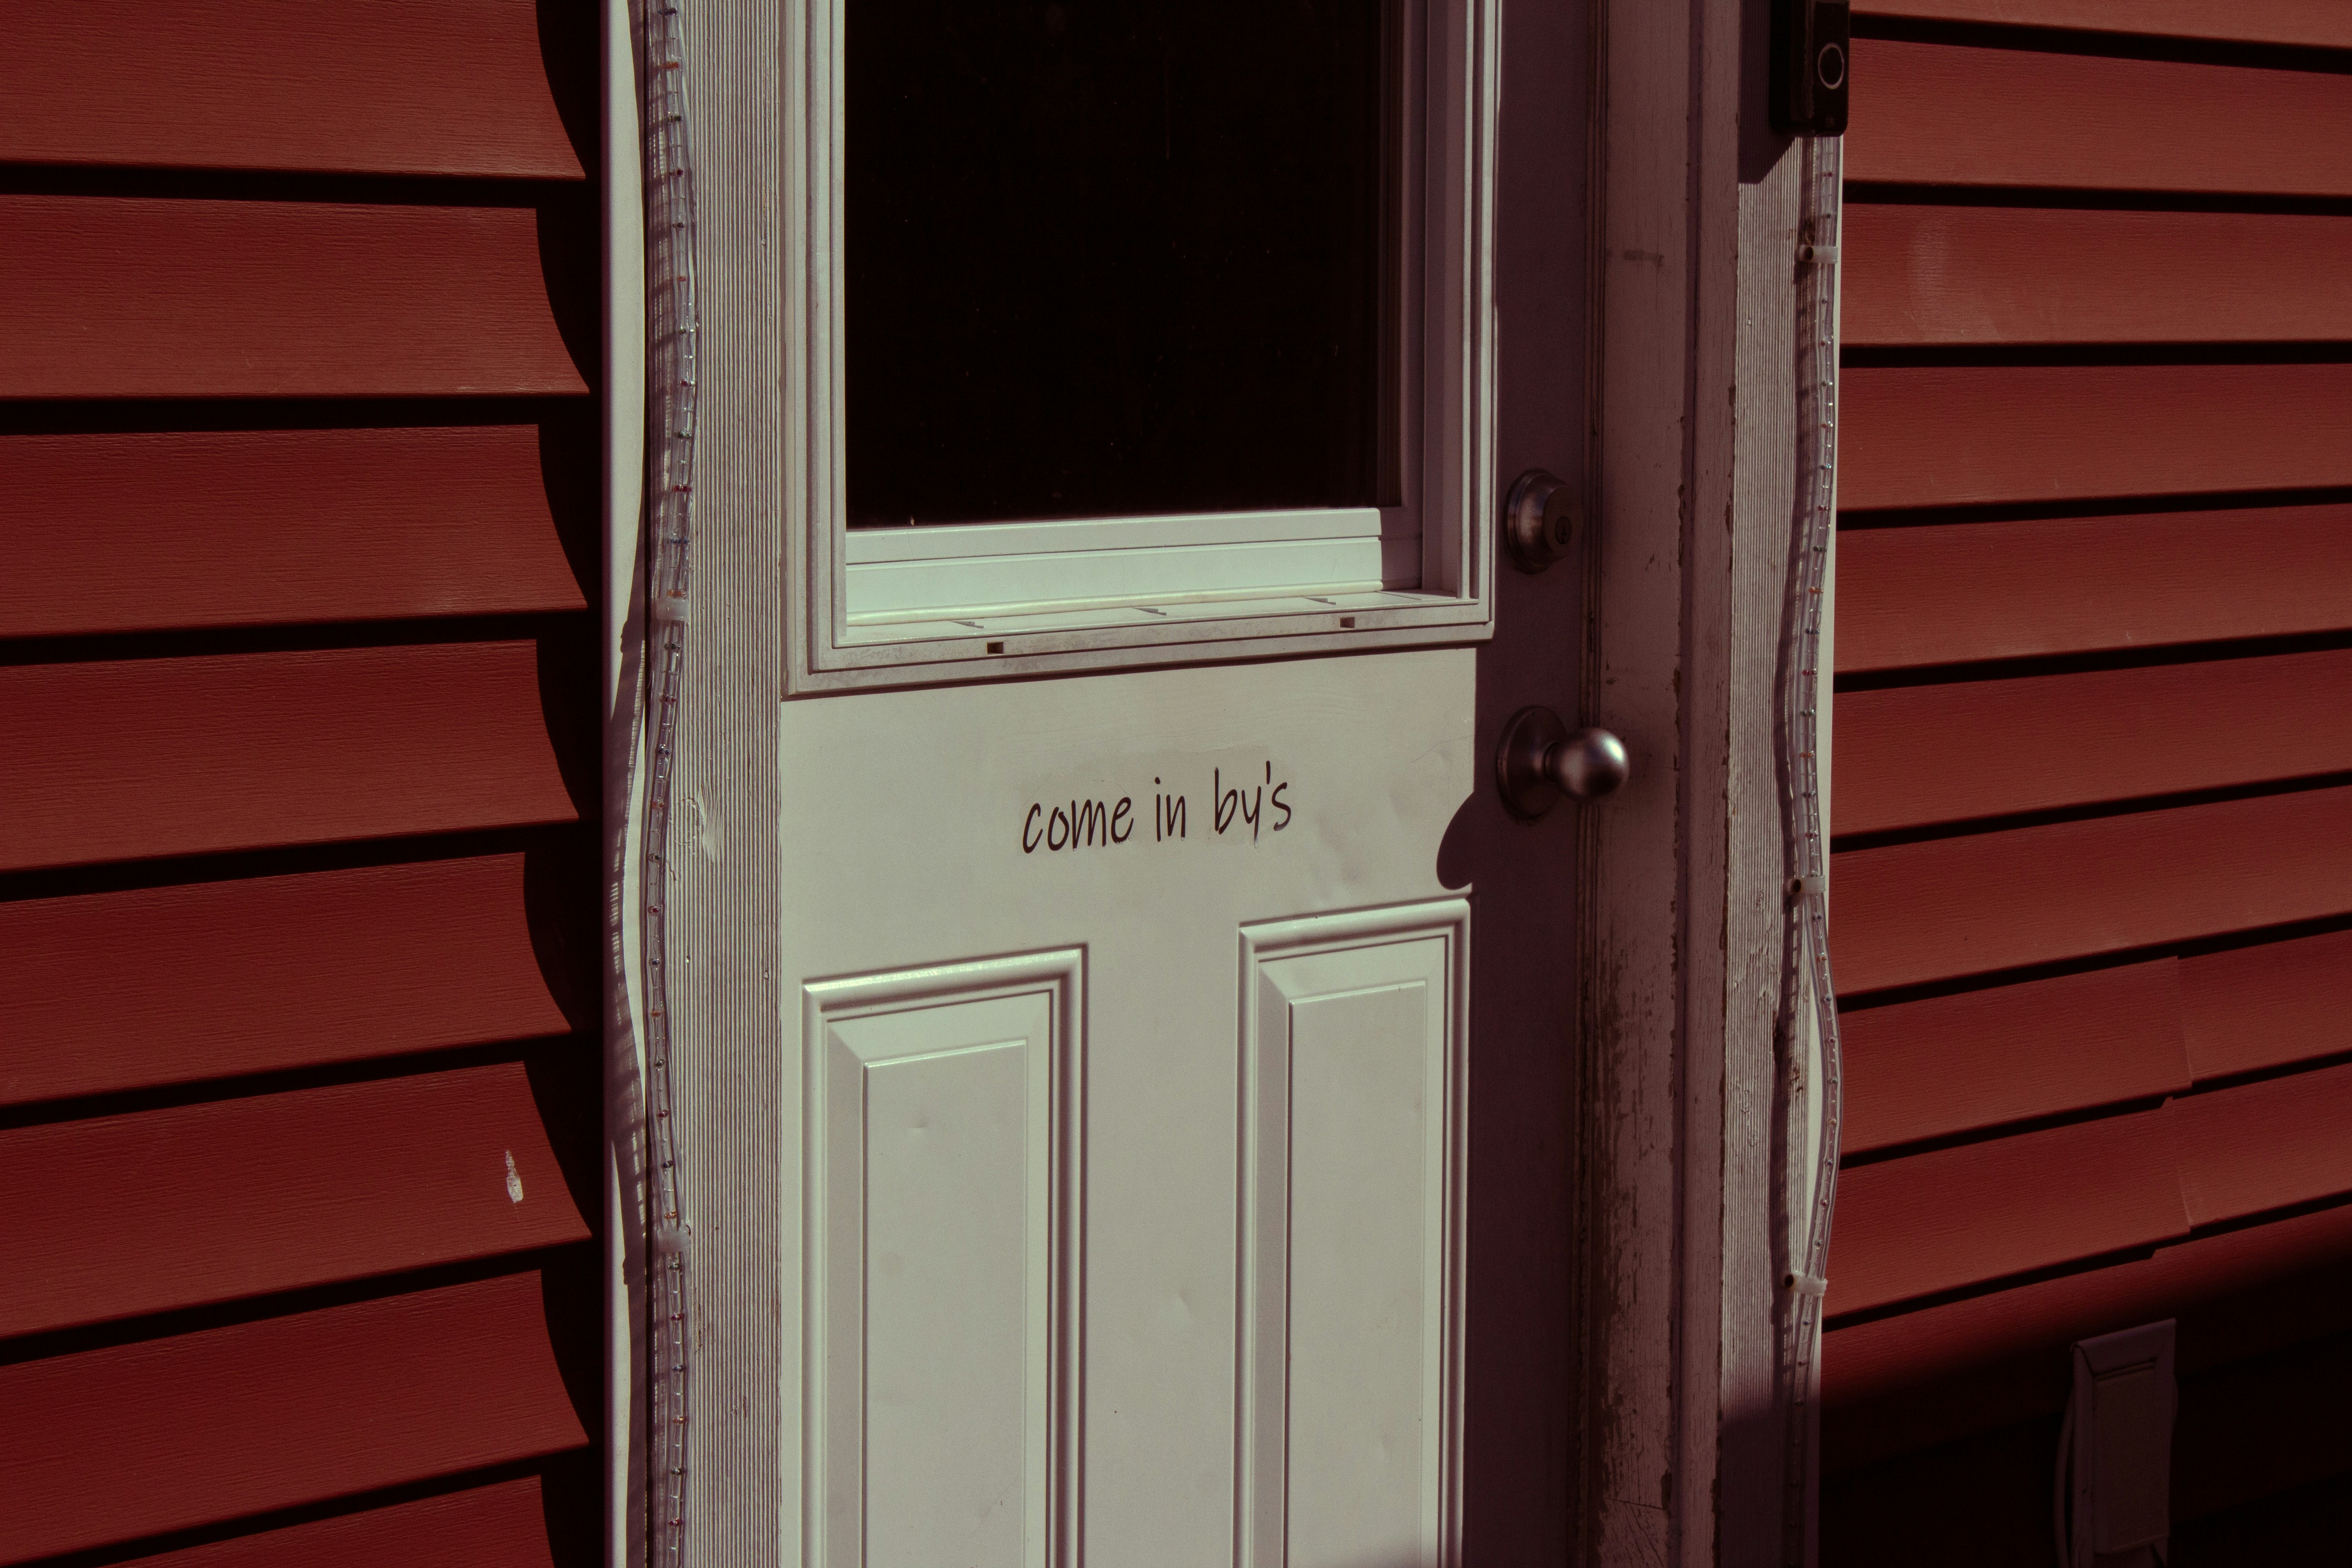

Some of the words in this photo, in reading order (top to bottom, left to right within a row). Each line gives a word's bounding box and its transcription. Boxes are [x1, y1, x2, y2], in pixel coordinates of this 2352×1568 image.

[1022, 796, 1135, 854] come
[1154, 776, 1186, 843] in
[1214, 760, 1292, 848] by's
